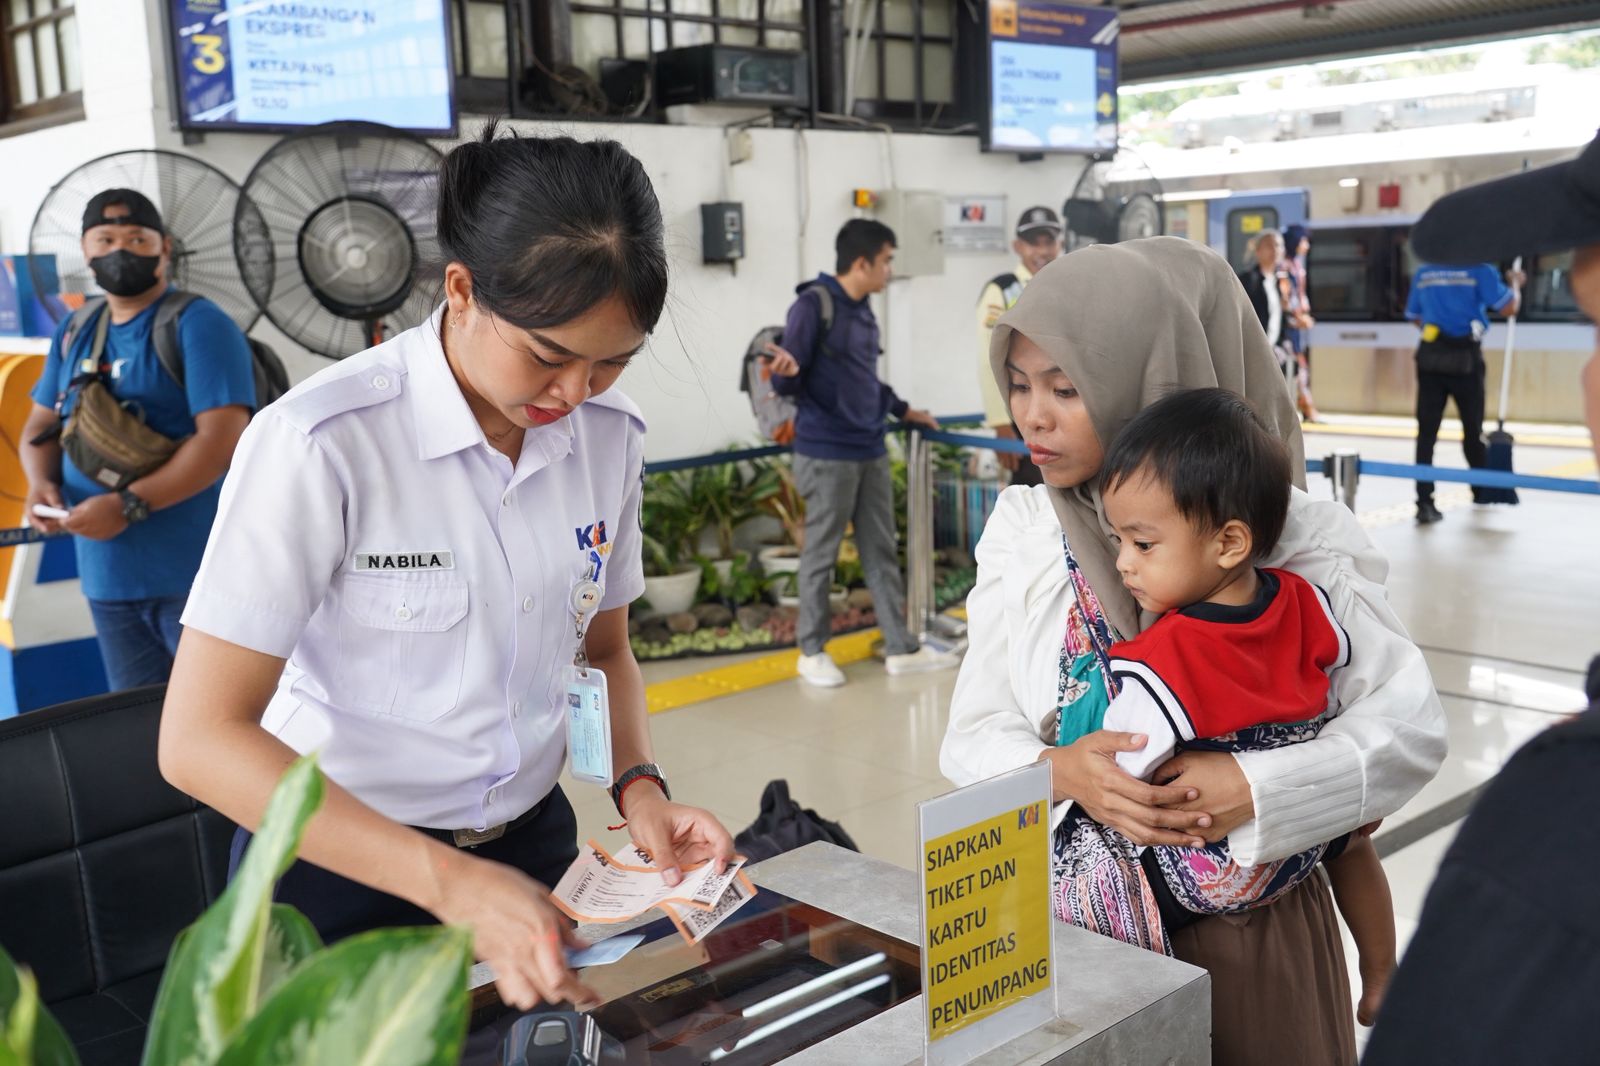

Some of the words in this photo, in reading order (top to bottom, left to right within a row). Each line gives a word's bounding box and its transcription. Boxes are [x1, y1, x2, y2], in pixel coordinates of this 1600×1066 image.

[191, 34, 225, 74] 3
[367, 554, 442, 569] NABILA
[1018, 803, 1040, 830] KAI
[927, 826, 1002, 872] SIAPKAN
[928, 873, 975, 909] TIKET
[980, 858, 1016, 890] DAN
[929, 907, 987, 948] KARTU
[930, 932, 1016, 986] IDENTITAS
[932, 958, 1048, 1029] PENUMPANG
